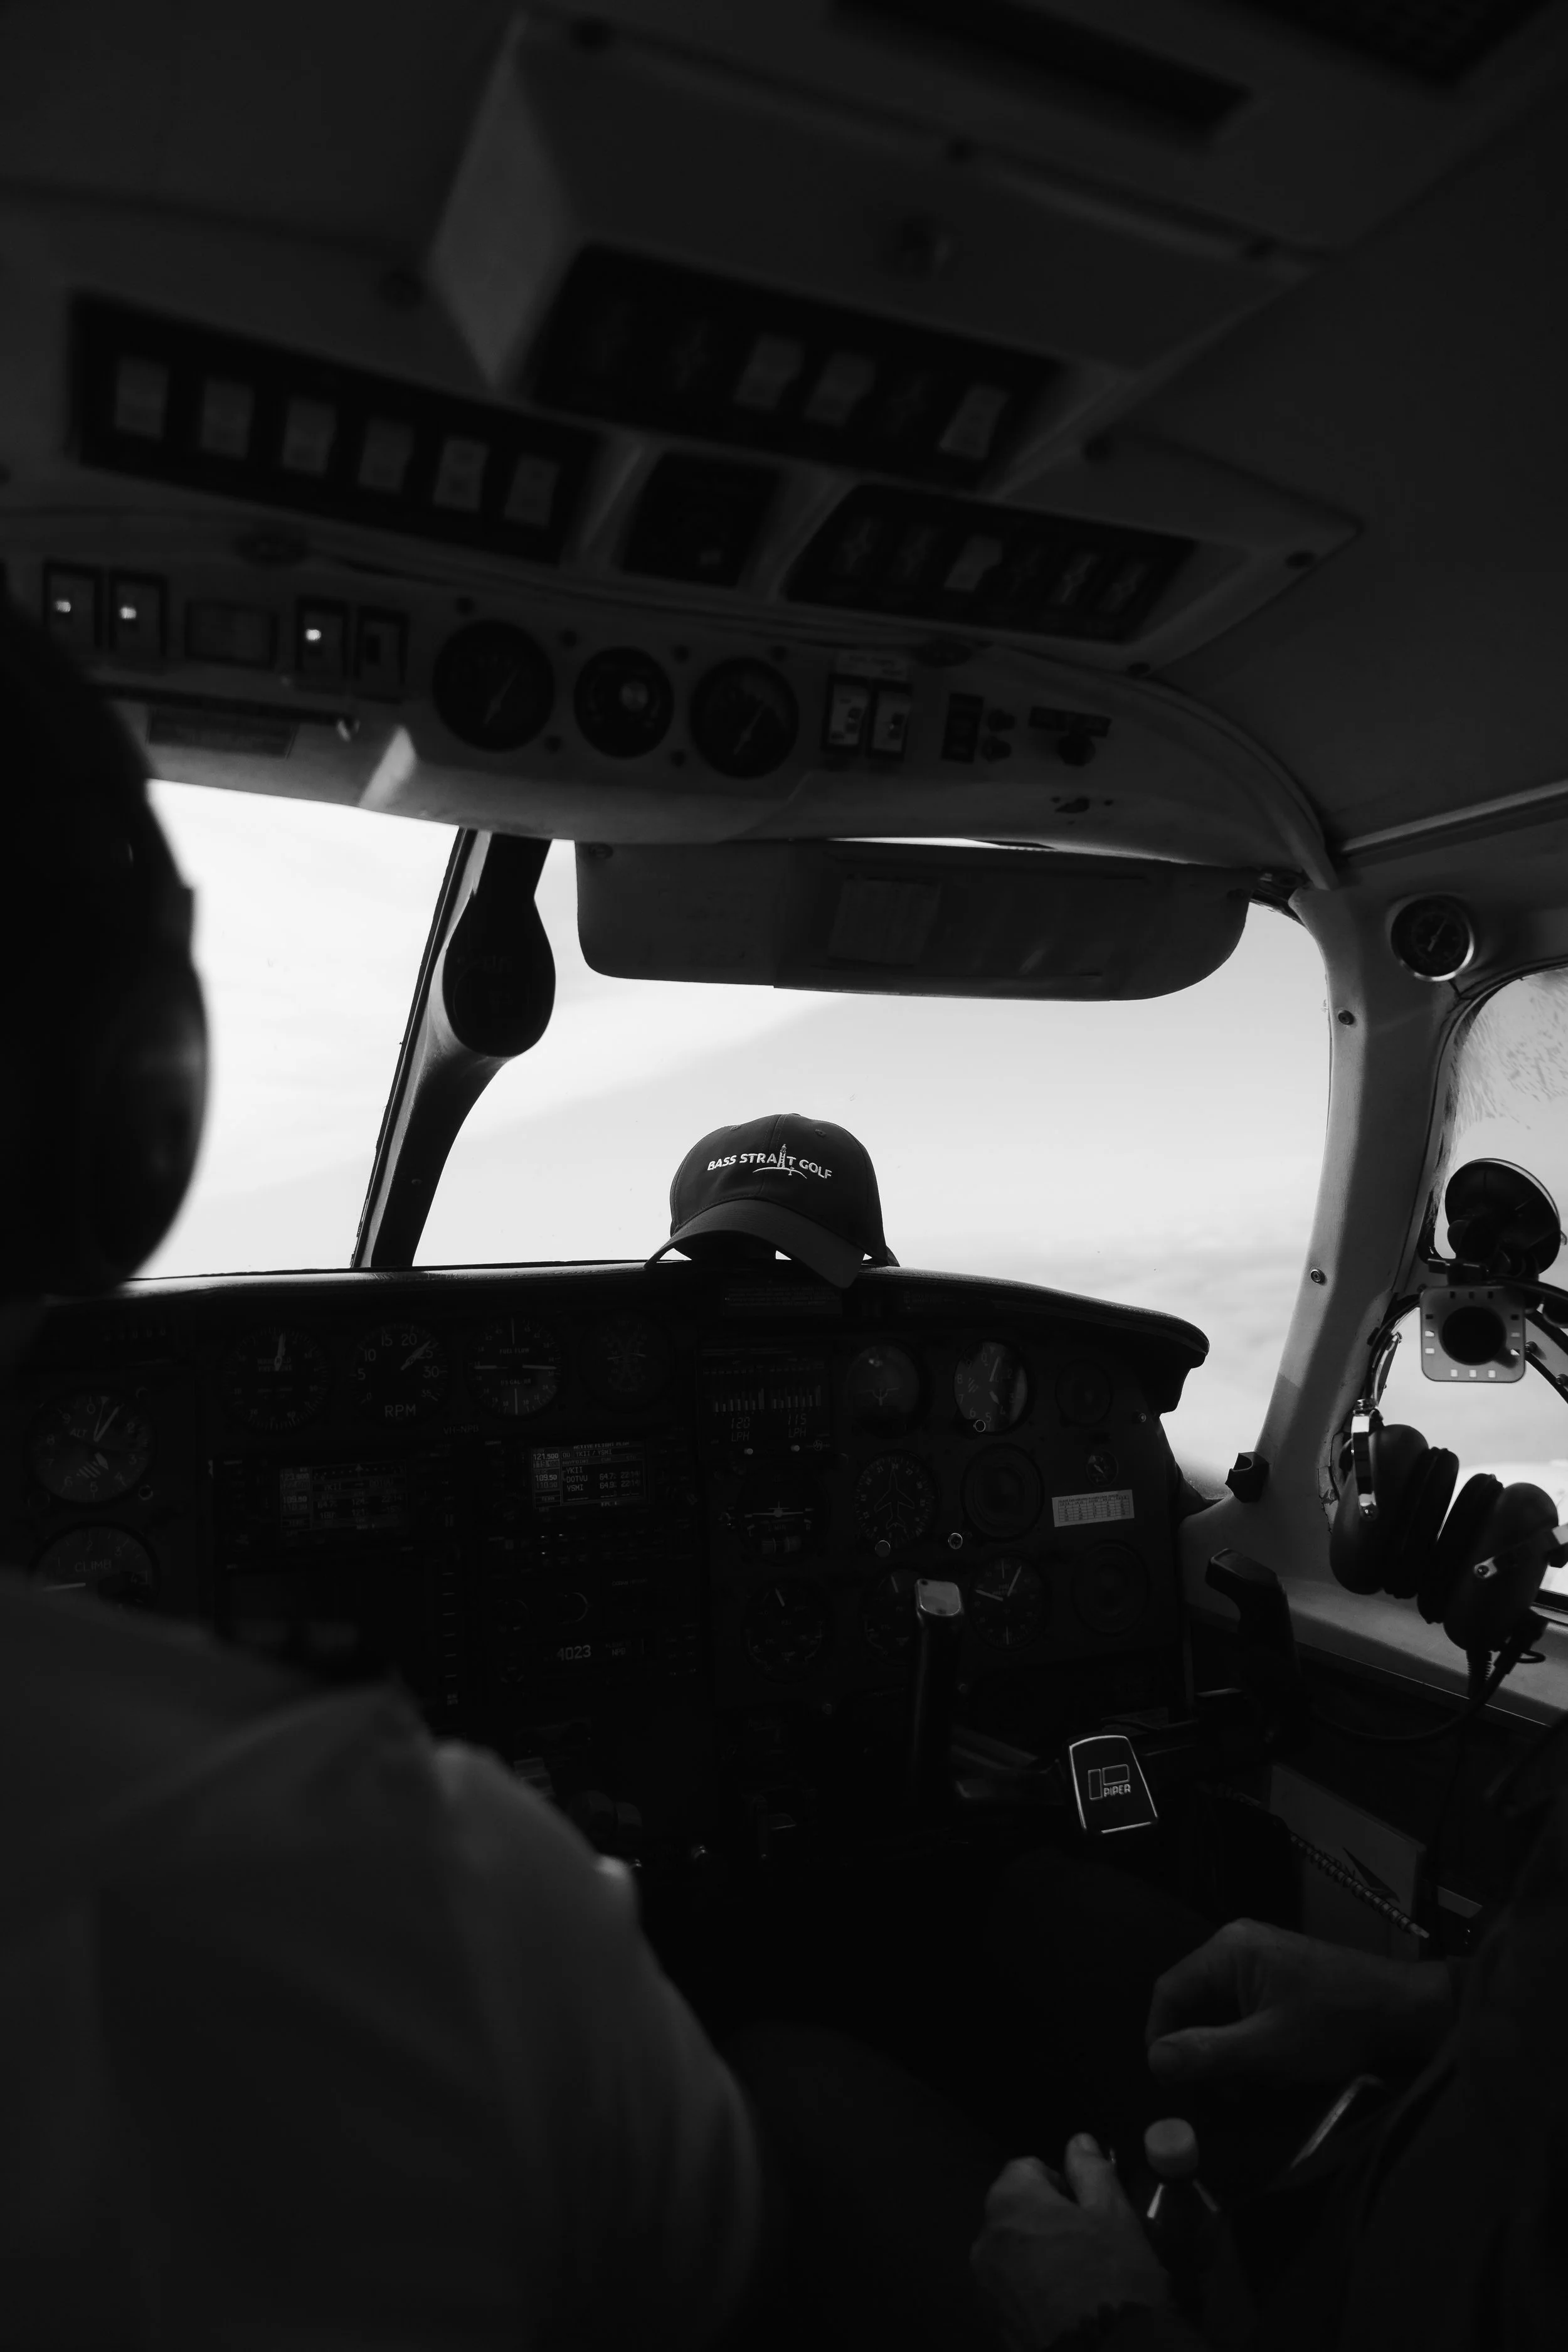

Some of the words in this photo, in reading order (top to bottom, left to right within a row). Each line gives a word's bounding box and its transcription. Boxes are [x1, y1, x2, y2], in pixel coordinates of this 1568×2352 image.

[707, 1155, 737, 1171] BASS
[739, 1146, 797, 1167] STRAIT
[799, 1159, 832, 1179] GOLF
[381, 1333, 393, 1347] 15
[401, 1333, 418, 1346] 20
[364, 1348, 377, 1362] 10
[981, 1352, 987, 1362] 0
[357, 1367, 366, 1380] 5
[422, 1365, 440, 1379] 30
[1007, 1368, 1014, 1379] 2
[956, 1374, 963, 1385] 8
[958, 1394, 965, 1406] 7
[87, 1403, 96, 1415] 0
[384, 1403, 416, 1418] RPM
[969, 1407, 976, 1418] 6
[62, 1412, 72, 1424] 9
[731, 1416, 751, 1429] 120
[787, 1412, 807, 1426] 115
[985, 1411, 992, 1423] 5
[127, 1421, 135, 1434] 2
[443, 1424, 479, 1436] VH-NPB
[788, 1427, 807, 1439] LPH
[46, 1433, 55, 1445] 8
[731, 1431, 750, 1443] LPH
[128, 1454, 137, 1465] 3
[533, 1453, 559, 1461] 121.500
[566, 1466, 584, 1475] YKII
[64, 1476, 73, 1487] 6
[566, 1475, 588, 1484] DOTVU
[90, 1481, 98, 1493] 5
[567, 1484, 584, 1492] YSMI
[86, 1539, 93, 1554] 2
[74, 1558, 112, 1573] CLIMB
[556, 1644, 591, 1661] 4023
[612, 1647, 626, 1656] NPB
[1104, 1784, 1131, 1797] PIPER
